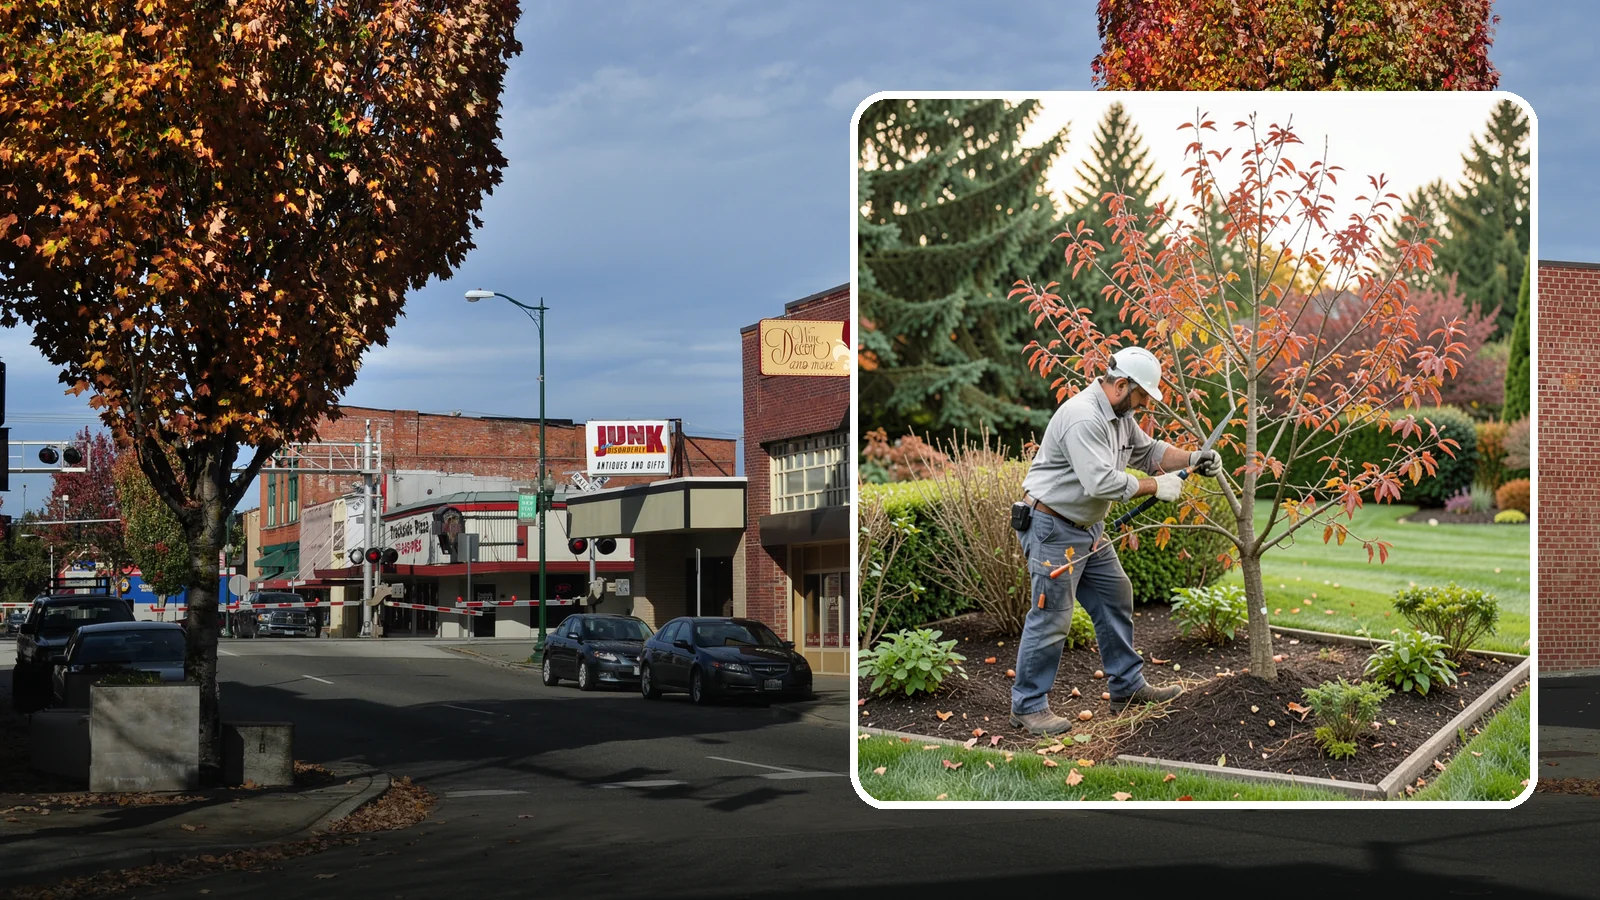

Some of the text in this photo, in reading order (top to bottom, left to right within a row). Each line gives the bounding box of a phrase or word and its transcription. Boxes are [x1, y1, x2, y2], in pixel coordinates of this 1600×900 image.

[595, 425, 664, 457] JUNK
[607, 446, 646, 454] DISORDERLY
[596, 460, 665, 470] ANTIQUES AND GIFTS
[390, 519, 429, 539] Trackside Pizza
